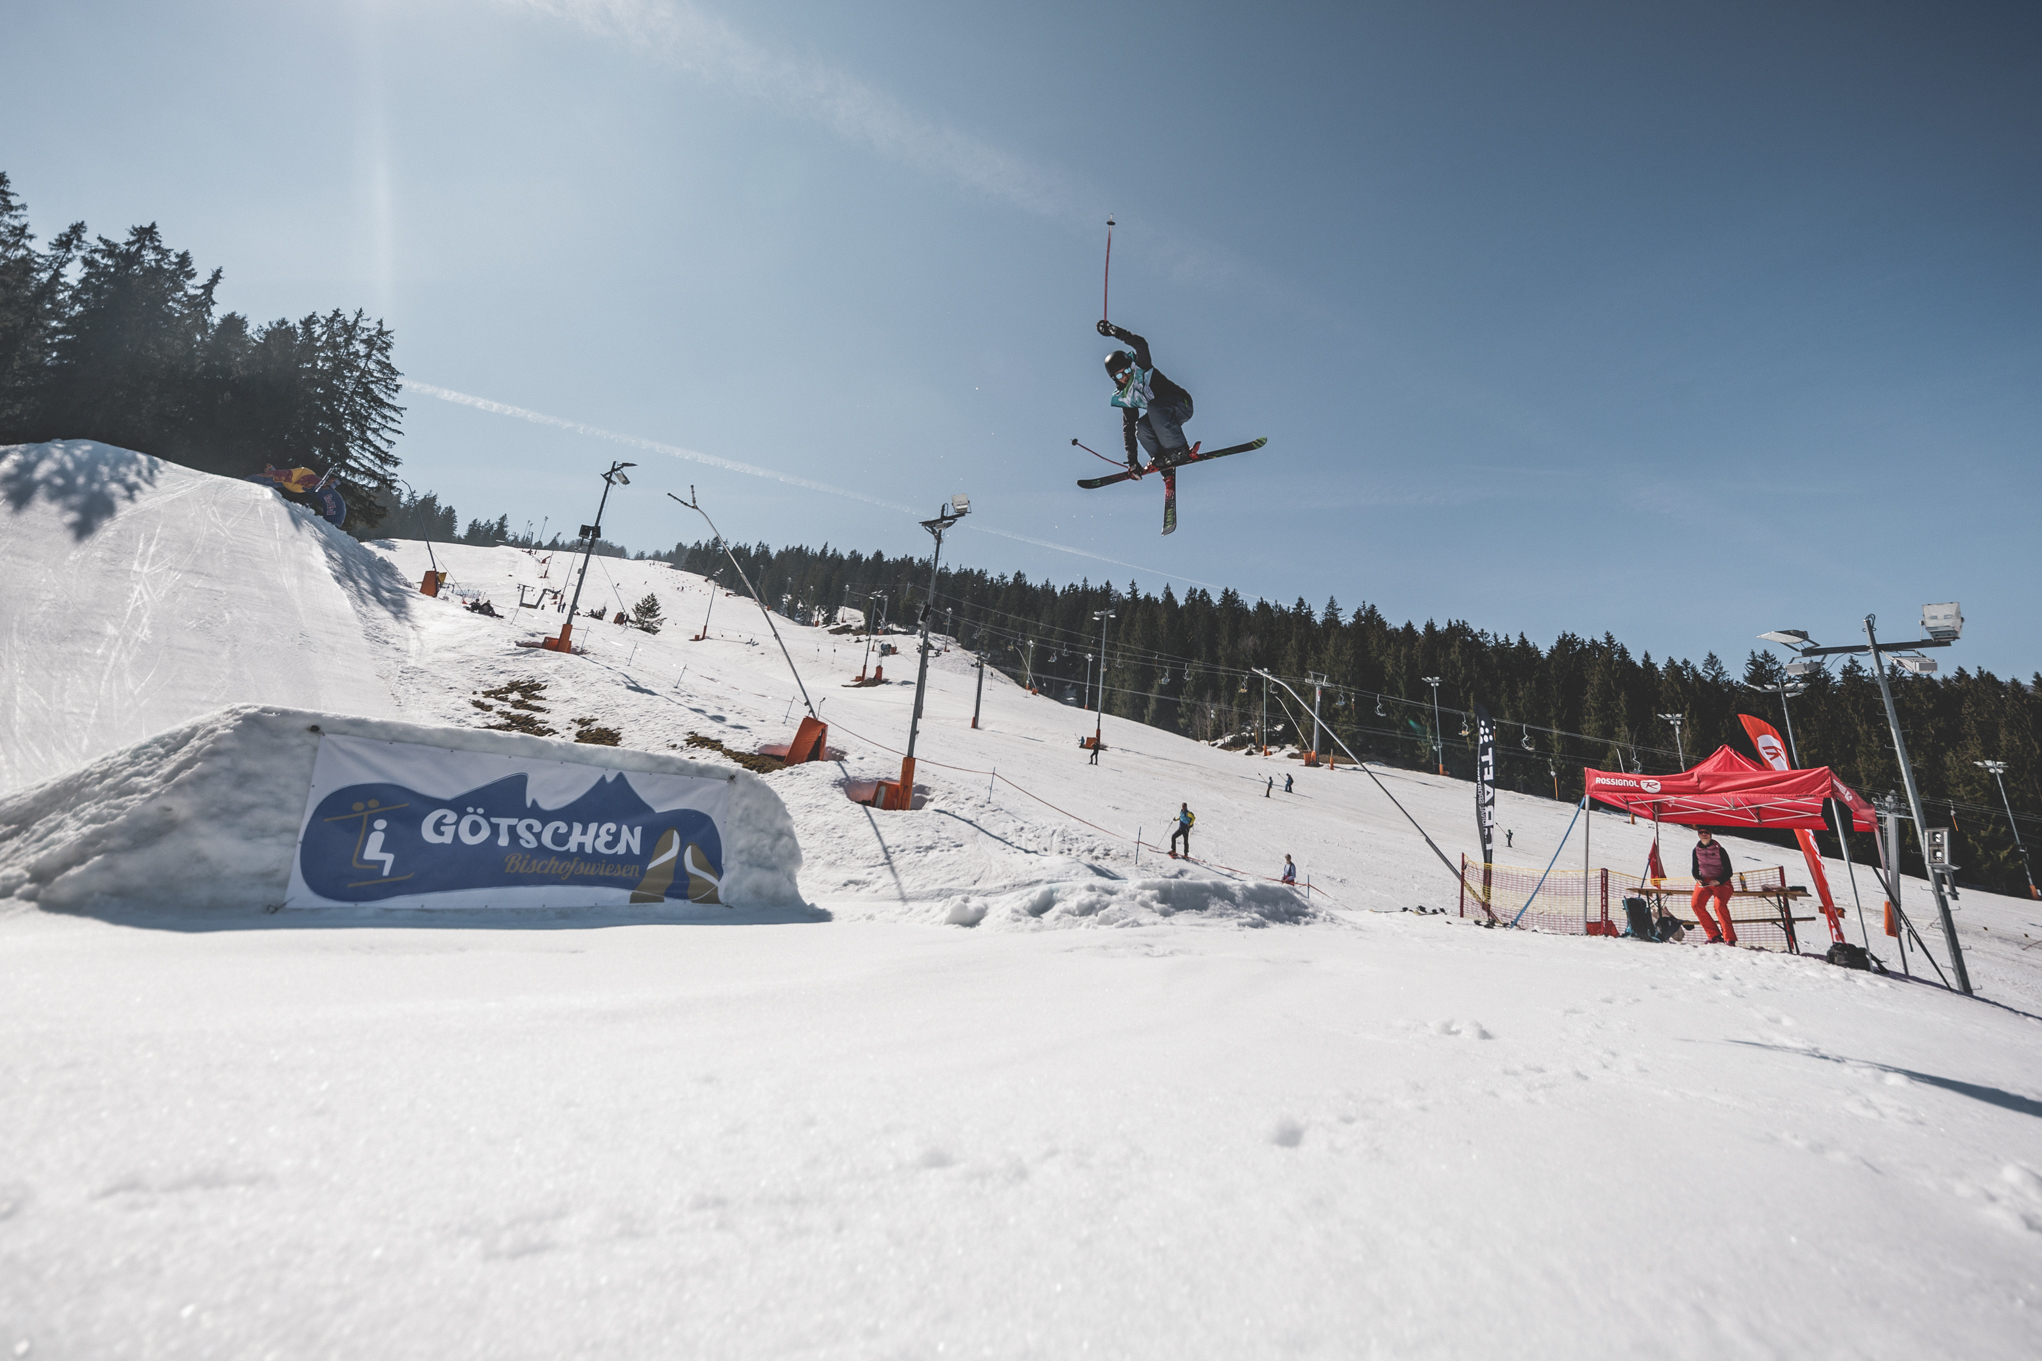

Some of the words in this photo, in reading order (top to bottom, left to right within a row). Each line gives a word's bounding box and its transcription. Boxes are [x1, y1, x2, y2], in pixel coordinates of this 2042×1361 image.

[1595, 777, 1639, 788] ROSSIGNOL
[421, 807, 642, 855] GÖTSCHEN
[504, 853, 640, 880] Bischofswiesen
